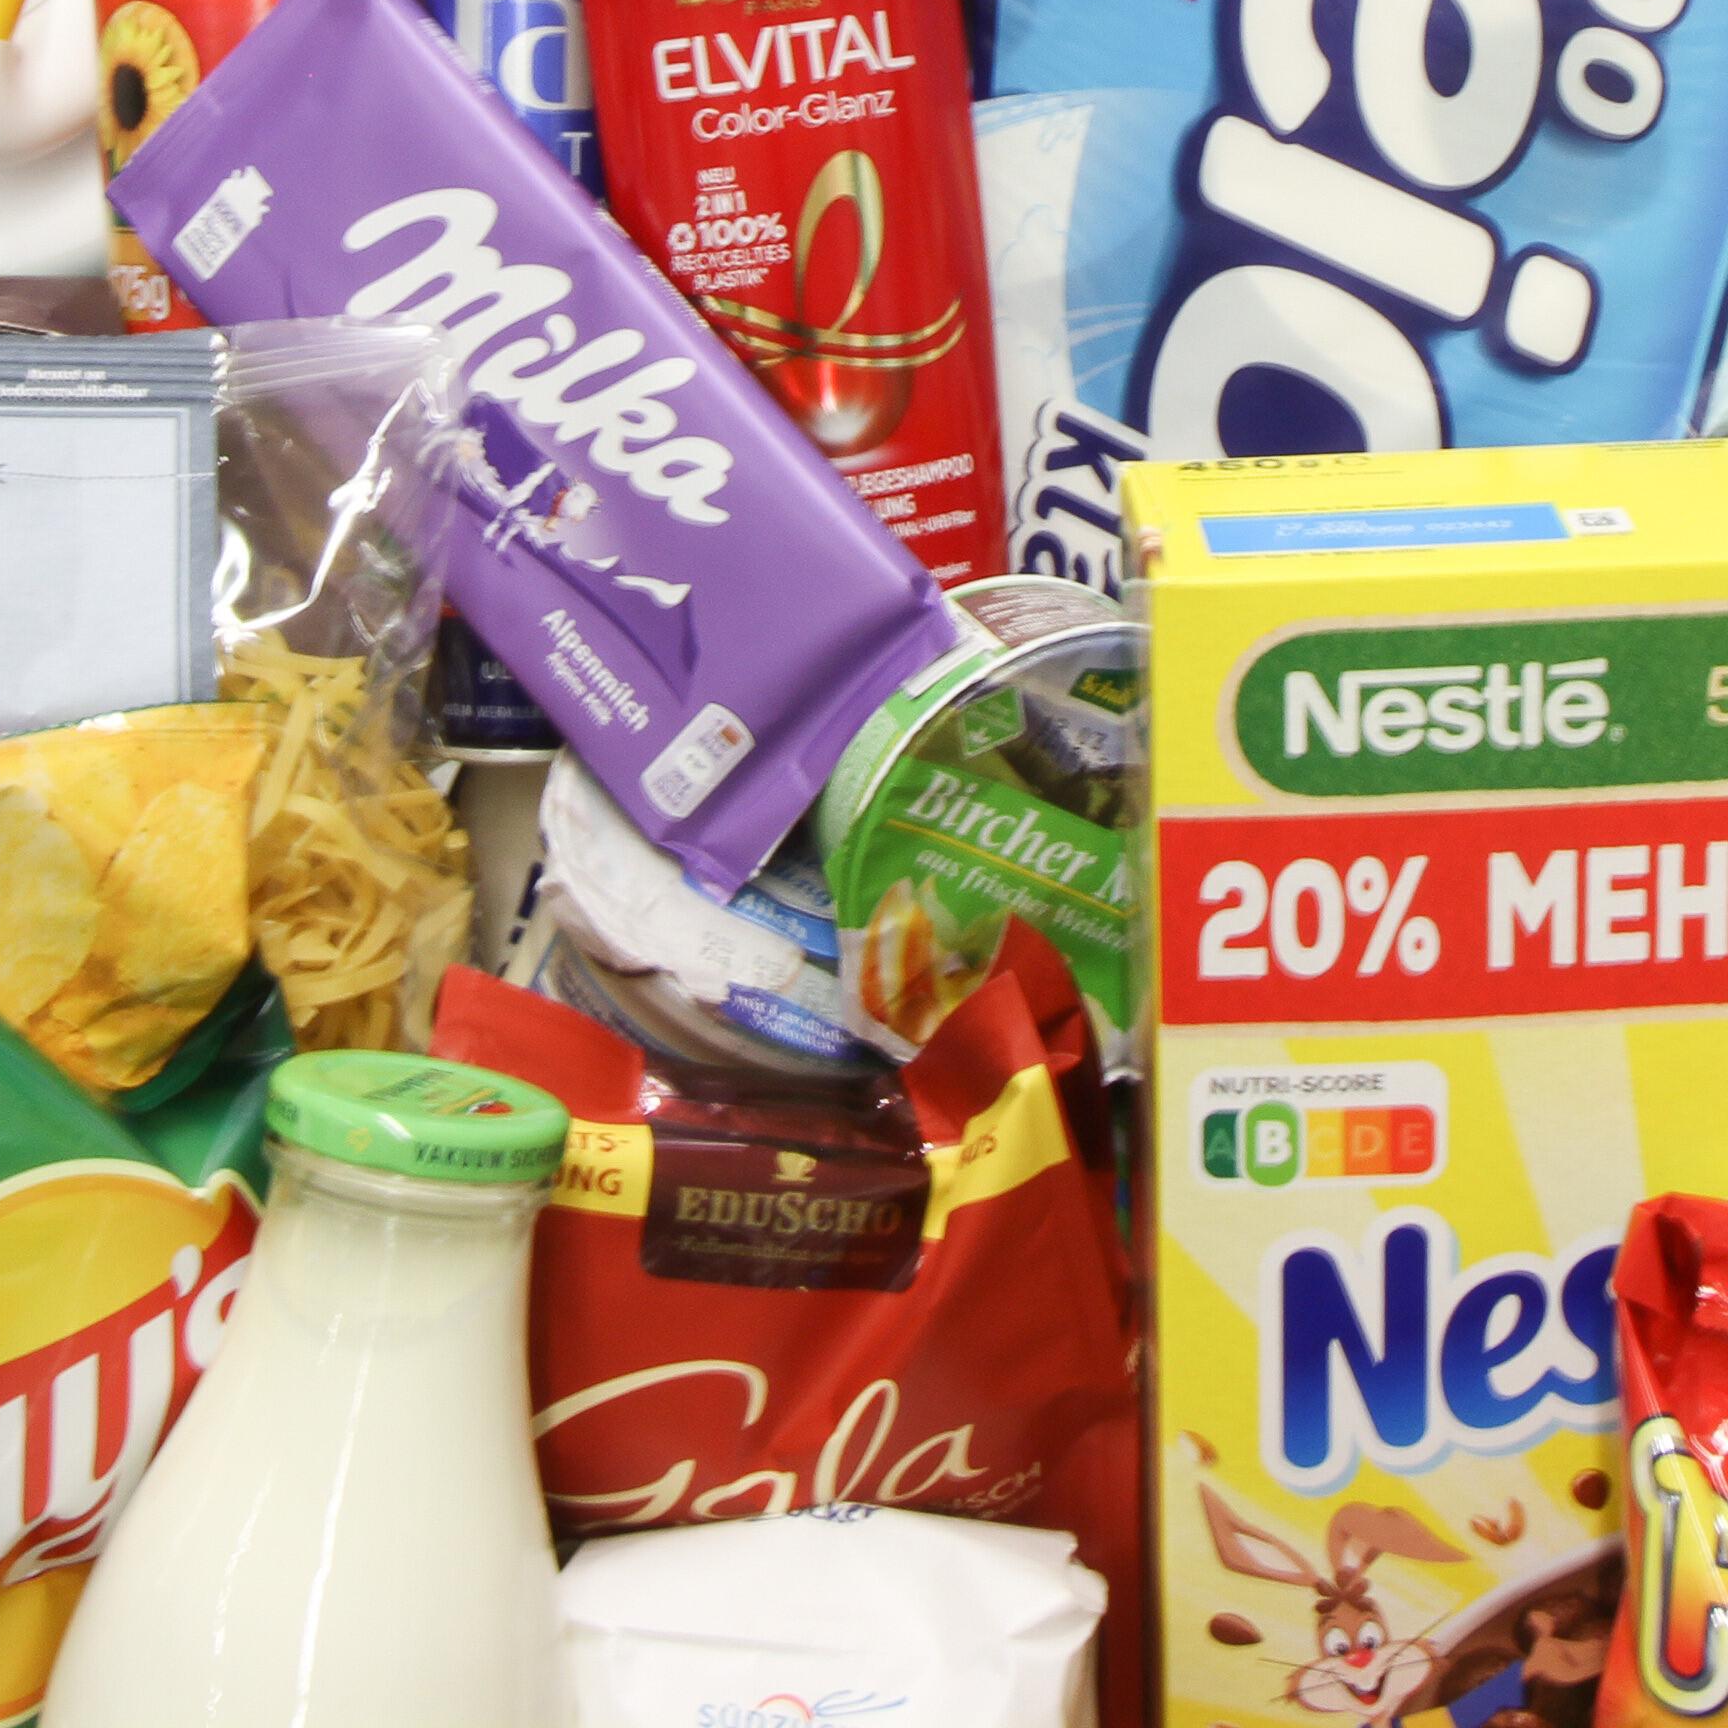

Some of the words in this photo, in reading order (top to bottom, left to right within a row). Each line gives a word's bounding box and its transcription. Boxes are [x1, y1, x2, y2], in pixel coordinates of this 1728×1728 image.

[652, 10, 916, 104] ELVITAL
[691, 88, 897, 143] Color-Glanz
[696, 212, 787, 249] 100%
[342, 186, 735, 528] Milka
[1176, 456, 1285, 474] 450
[539, 607, 650, 735] Alpenmilch
[1282, 657, 1610, 759] Nestlé
[904, 770, 1100, 886] Bircher
[915, 847, 962, 876] aus
[954, 868, 1052, 921] frischer
[1196, 855, 1442, 983] 20%
[1208, 1073, 1387, 1097] NUTRI-SCORE
[1253, 1118, 1295, 1169] B
[1349, 1122, 1387, 1161] D
[1399, 1122, 1428, 1159] E
[674, 1185, 904, 1236] EDUSCHO
[530, 1358, 992, 1524] Gala
